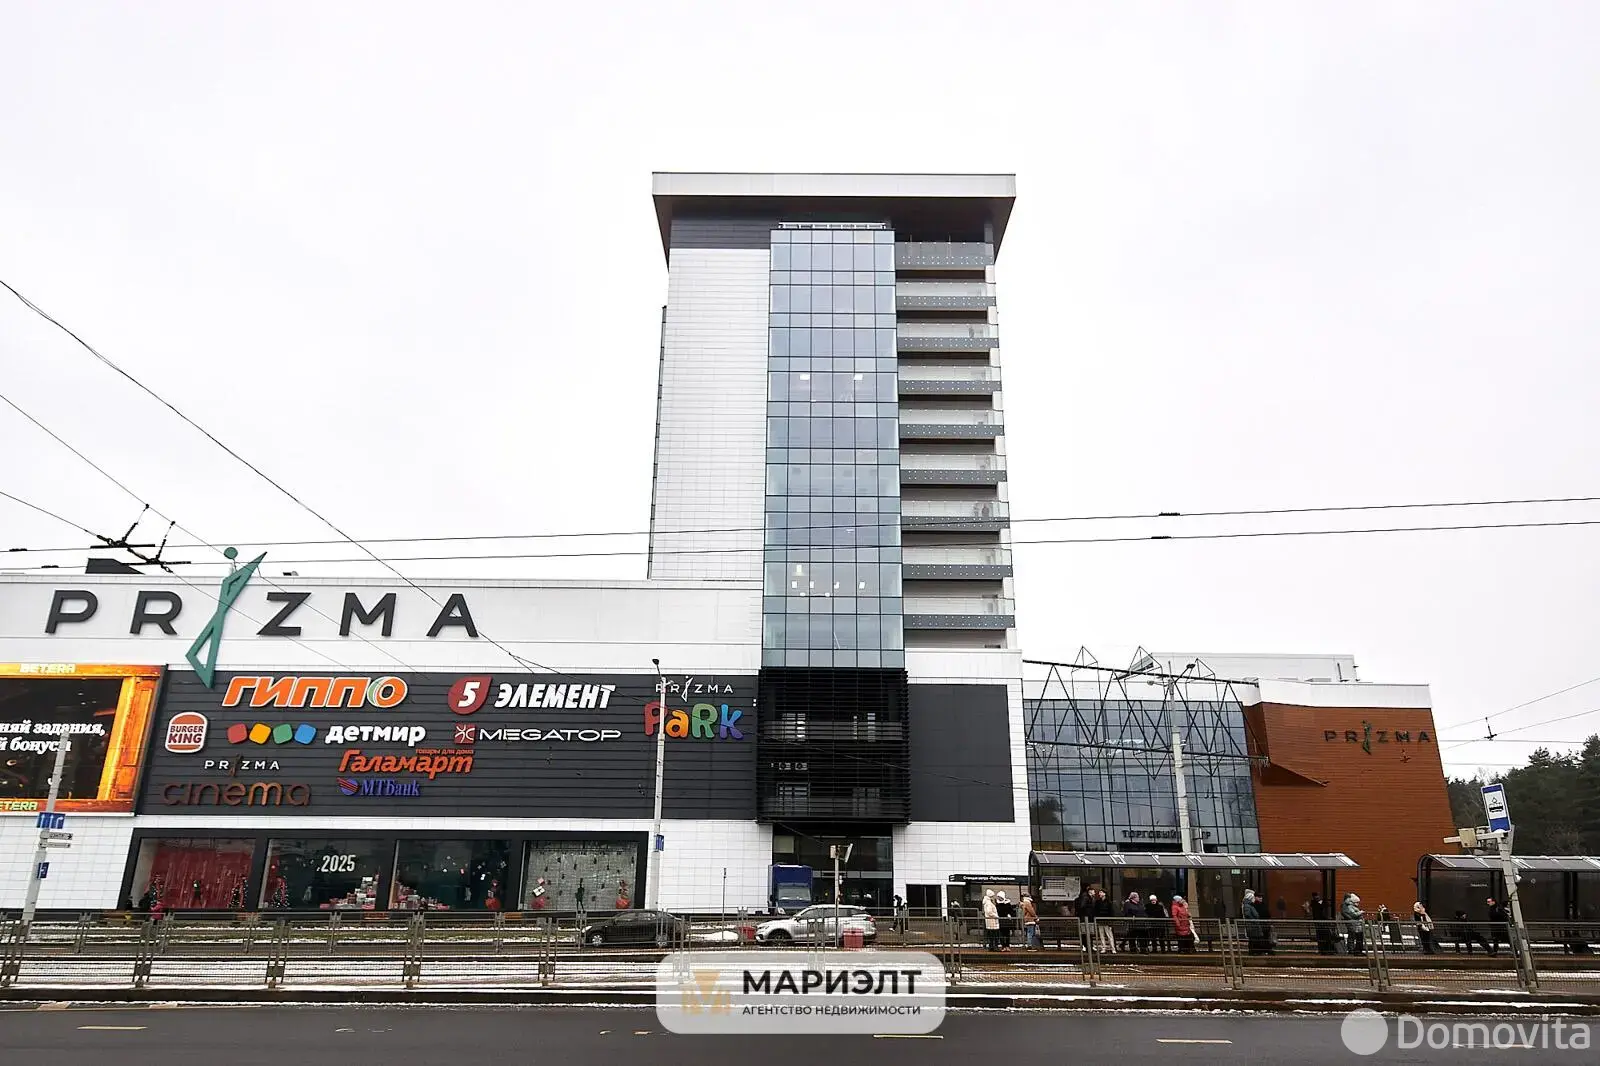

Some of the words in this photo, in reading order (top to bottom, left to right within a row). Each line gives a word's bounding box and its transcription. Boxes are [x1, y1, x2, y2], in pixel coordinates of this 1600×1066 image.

[221, 676, 408, 708] ГИППО
[457, 681, 480, 708] 5
[494, 683, 616, 709] ЭЛЕМЕНТ
[168, 733, 202, 744] KING
[170, 725, 204, 733] BURGER
[324, 725, 426, 747] детмир
[479, 728, 622, 742] MEGATOP
[338, 750, 473, 779] Галамарт
[163, 781, 312, 808] cinema
[360, 778, 420, 797] МТБанк
[320, 854, 357, 873] 2025
